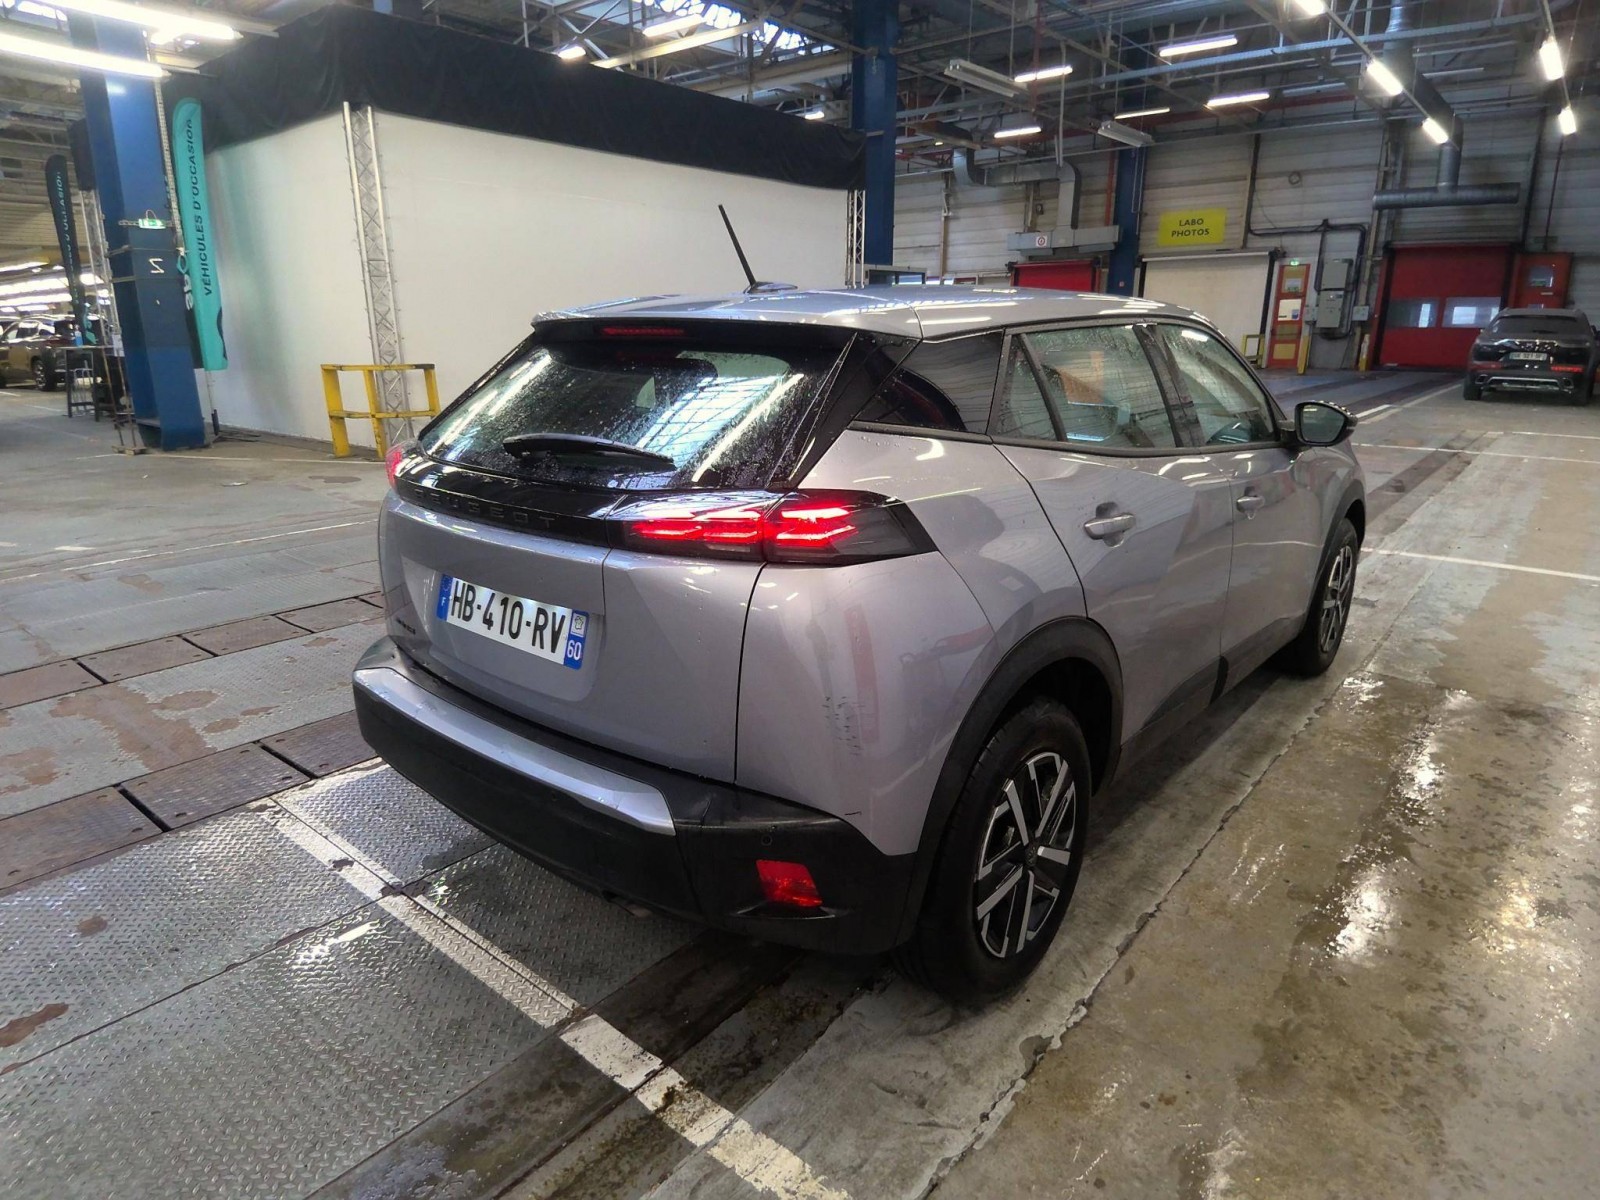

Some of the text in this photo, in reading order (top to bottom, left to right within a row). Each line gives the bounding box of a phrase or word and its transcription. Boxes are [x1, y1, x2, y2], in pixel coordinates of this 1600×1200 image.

[1171, 228, 1210, 238] PHOTOS
[1179, 217, 1204, 227] LABO
[193, 216, 213, 296] VÉHICULES
[451, 580, 566, 654] HB-410-RV
[566, 639, 582, 661] 60
